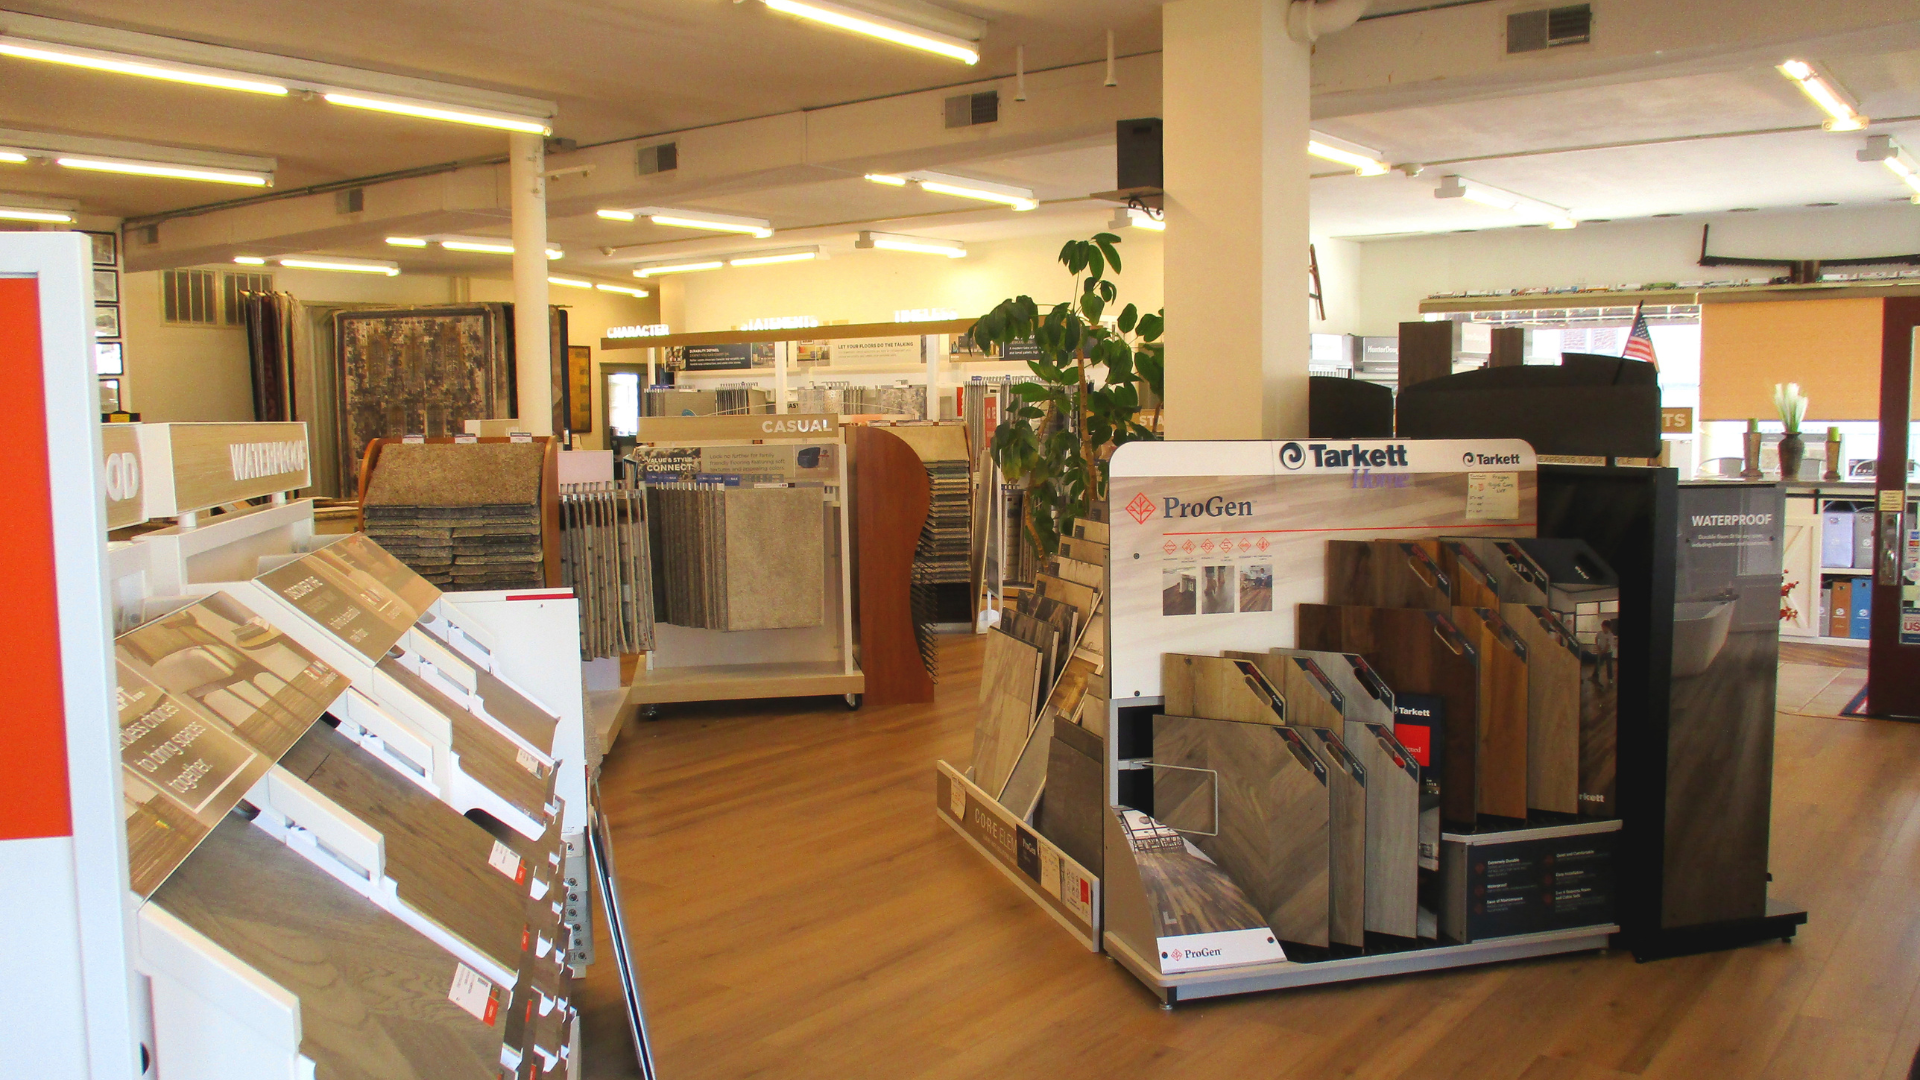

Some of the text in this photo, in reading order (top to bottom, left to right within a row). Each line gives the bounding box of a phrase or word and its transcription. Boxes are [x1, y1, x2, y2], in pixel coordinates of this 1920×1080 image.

[606, 324, 670, 338] CHARACTER
[761, 419, 833, 433] CASUAL
[229, 440, 306, 481] WATERPROOF
[1308, 443, 1408, 468] Tarkett
[1476, 454, 1520, 464] Tarkett
[646, 464, 692, 472] CONNECT
[1351, 468, 1410, 488] Home
[1163, 495, 1253, 518] ProGen
[1692, 514, 1773, 526] WATERPROOF
[140, 702, 180, 729] choices
[1398, 706, 1430, 716] Tarkett
[134, 721, 206, 773] to bring spaces
[164, 758, 214, 794] together.
[974, 808, 998, 839] CORE
[1184, 946, 1222, 959] ProGen
